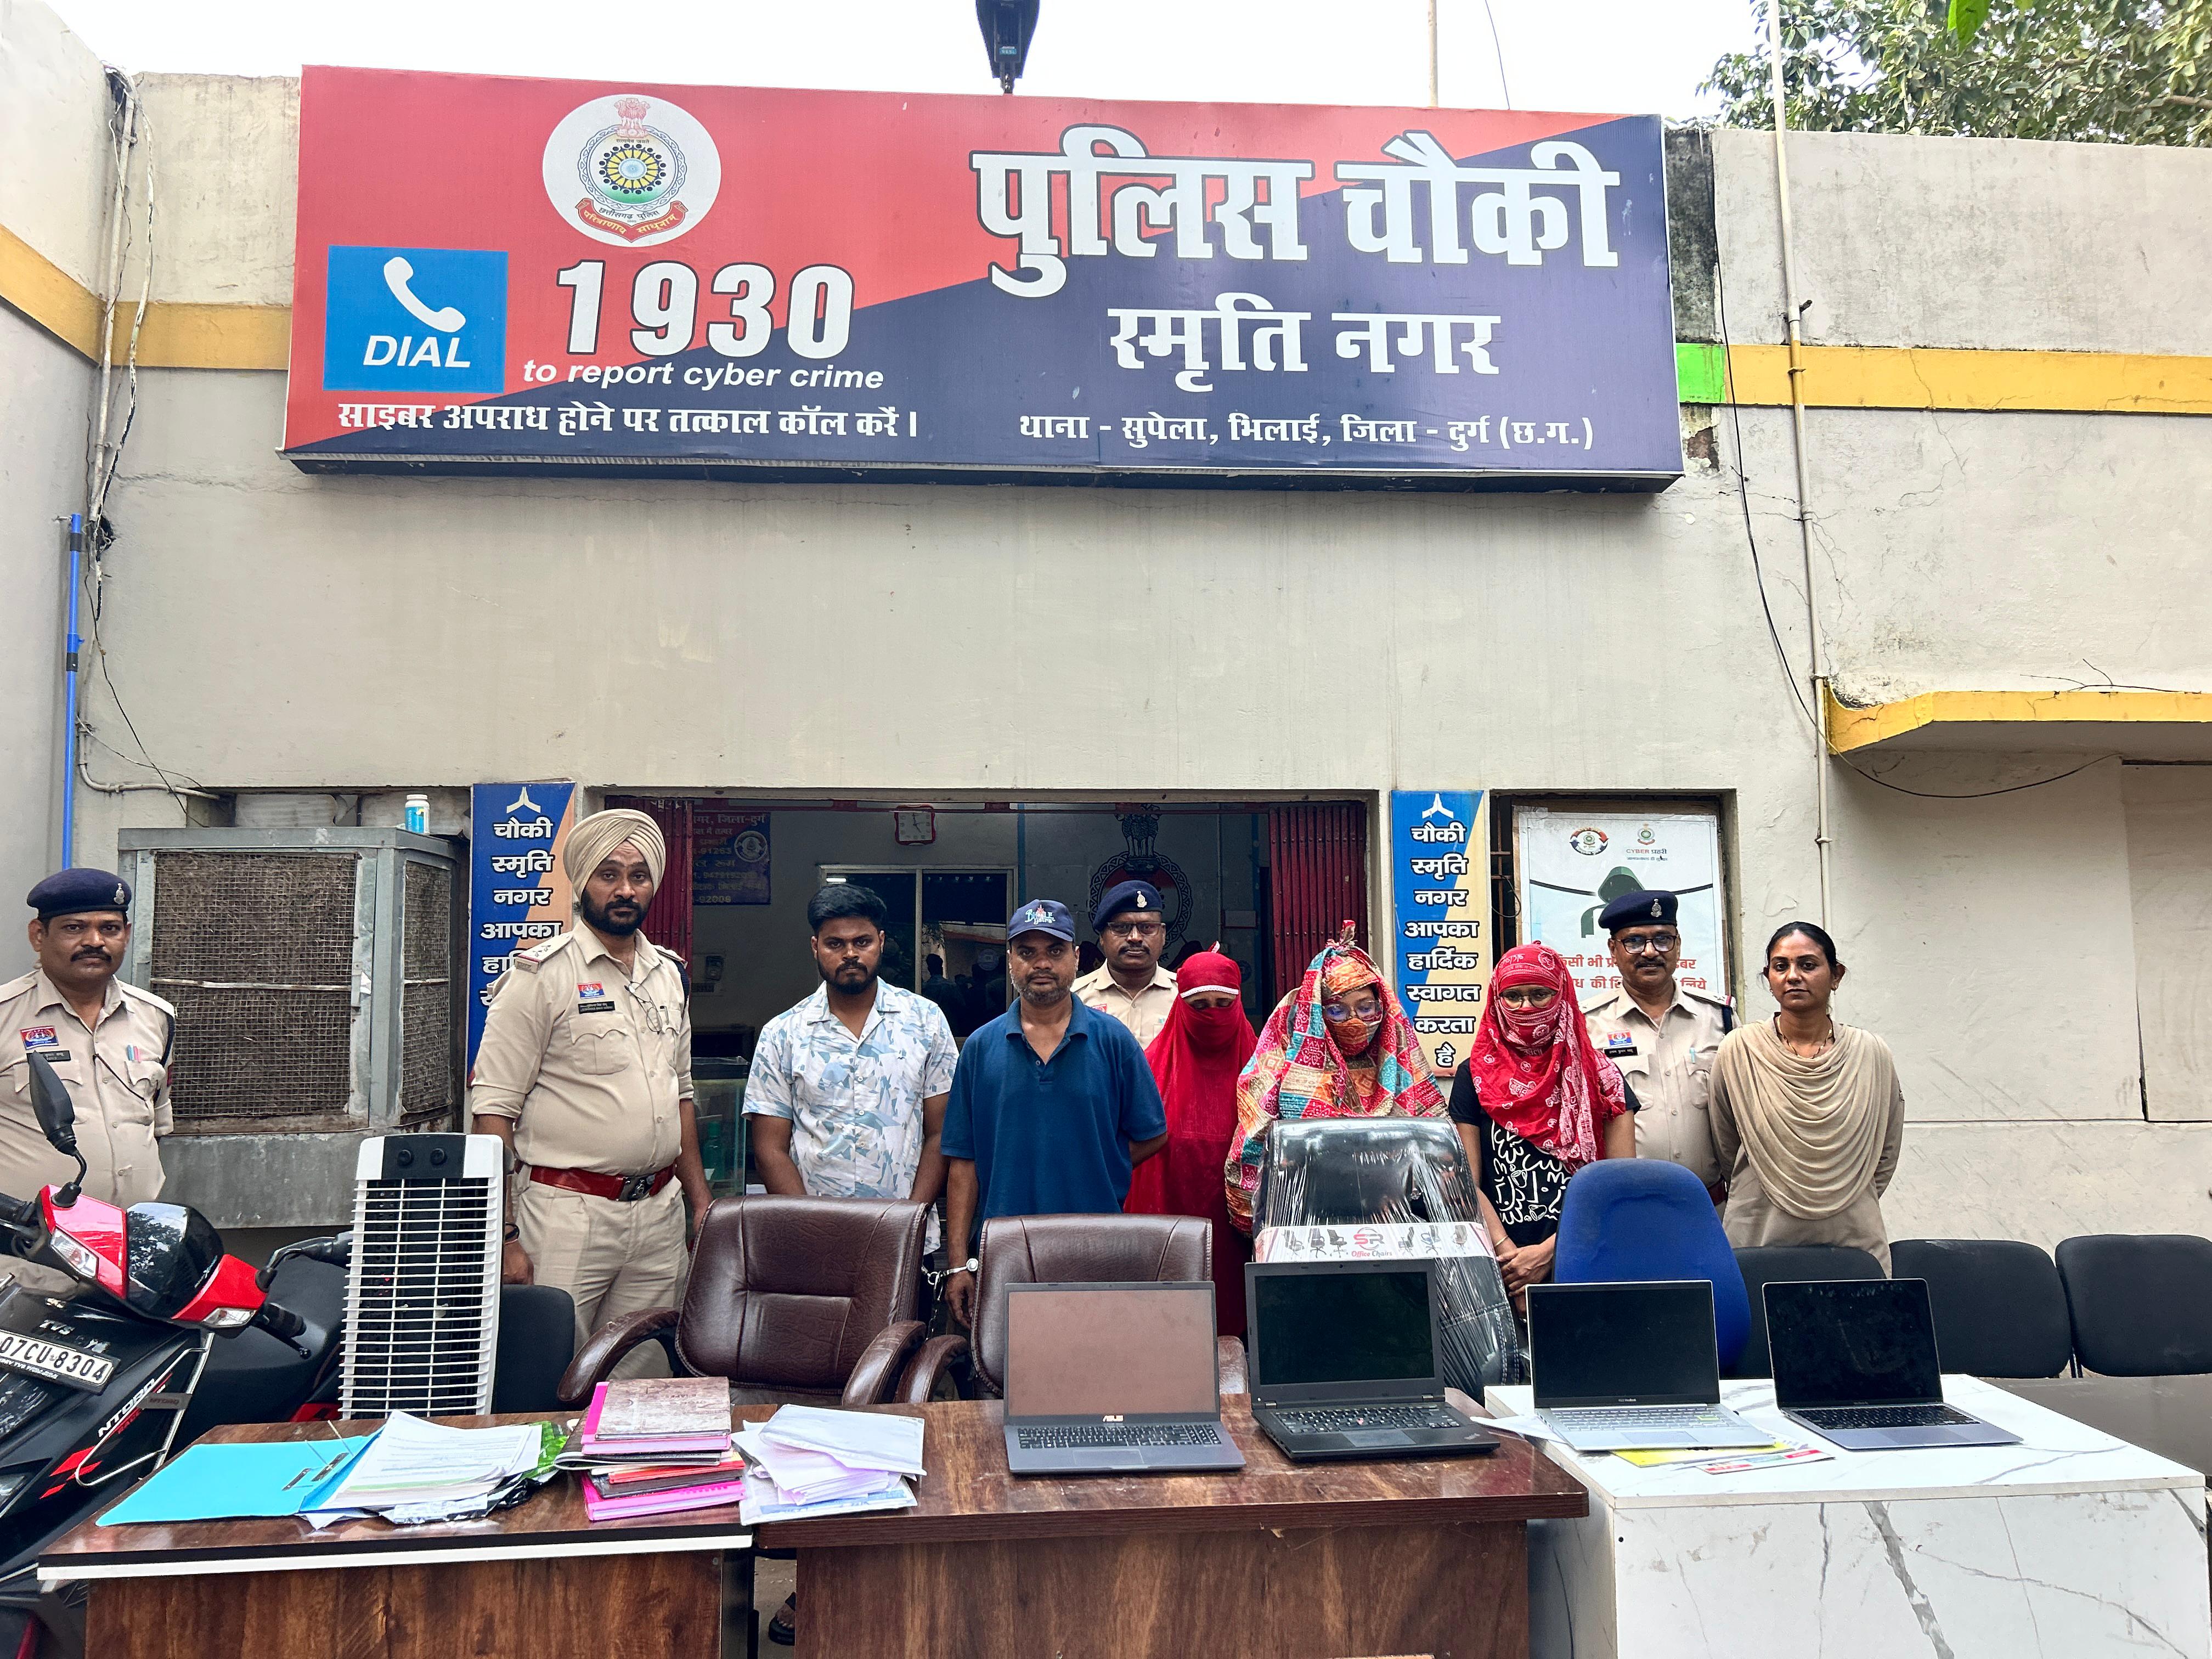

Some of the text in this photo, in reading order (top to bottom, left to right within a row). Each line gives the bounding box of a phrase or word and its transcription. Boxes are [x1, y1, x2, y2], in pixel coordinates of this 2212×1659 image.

[636, 211, 660, 221] पुलिस
[973, 127, 1620, 297] पुलिस चौकी
[559, 262, 852, 358] 1930
[363, 336, 470, 367] DIAL
[1108, 292, 1501, 392] स्मृति नगर
[524, 360, 883, 391] to report cyber crime
[338, 404, 436, 430] साइबर
[444, 405, 551, 430] अपराध
[558, 402, 614, 435] होने
[623, 409, 661, 431] पर
[668, 409, 771, 433] तत्काल
[778, 405, 848, 435] कॉल
[1020, 416, 1090, 438] थाना
[1121, 412, 1218, 448] सुपेला,
[1228, 413, 1330, 445] भिलाई,
[1340, 414, 1417, 442] जिला
[1447, 415, 1491, 452] दुर्ग
[1500, 416, 1593, 450] (छ.ग.)
[494, 817, 553, 838] चौकी
[1412, 822, 1465, 842] चौकी
[492, 850, 552, 878] स्मृति
[1412, 854, 1466, 879] स्मृति
[494, 888, 552, 904] नगर
[1415, 891, 1468, 906] नगर
[481, 923, 561, 939] आपका
[1405, 923, 1478, 937] आपका
[1408, 947, 1476, 970] हार्दिक
[1588, 955, 1603, 967] भी
[1591, 975, 1607, 988] की
[1407, 986, 1480, 1002] स्वागत
[1414, 1018, 1475, 1033] करता
[1435, 1042, 1455, 1066] है
[1353, 1233, 1385, 1245] SR
